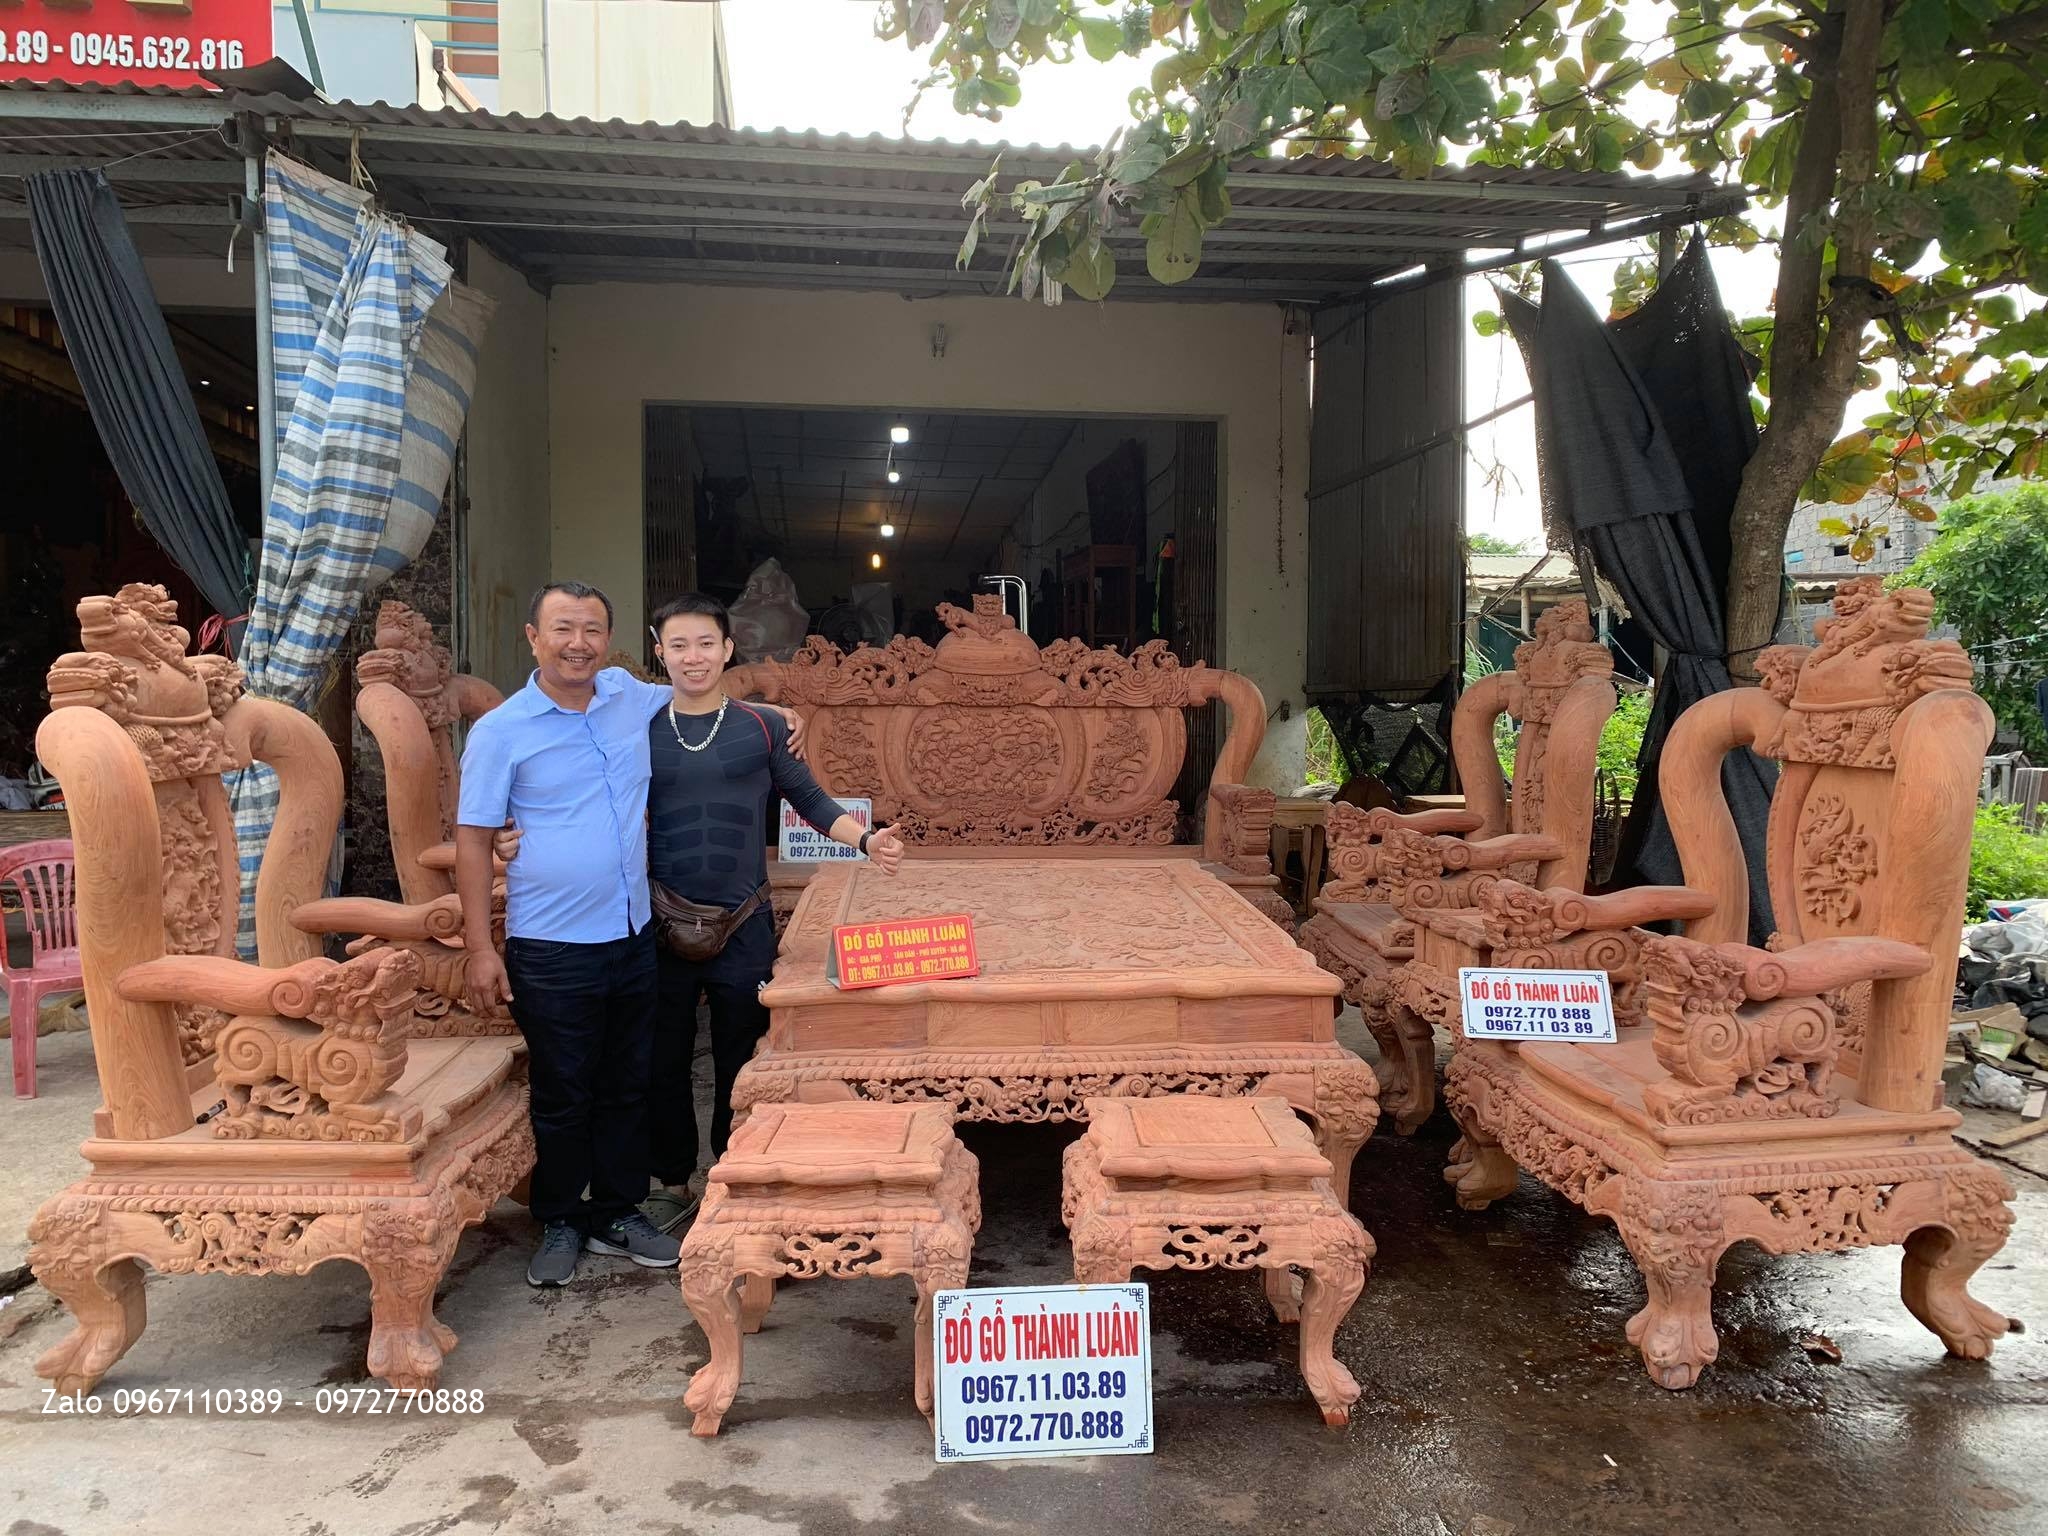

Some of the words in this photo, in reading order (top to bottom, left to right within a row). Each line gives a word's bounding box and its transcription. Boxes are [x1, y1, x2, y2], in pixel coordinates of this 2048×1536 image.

[70, 32, 244, 70] 0945.632.816
[790, 846, 857, 857] 0972.770.888
[843, 929, 862, 951] ĐỒ
[866, 927, 884, 949] GỖ
[886, 926, 930, 947] THÀNH
[933, 922, 967, 943] LUÂN
[862, 961, 915, 980] 0967.11.03.89
[921, 956, 969, 974] 0972.770.888
[1471, 976, 1490, 1000] ĐỒ
[1494, 976, 1511, 1001] GỖ
[1515, 979, 1560, 1002] THÀNH
[1563, 982, 1600, 1004] LUÂN
[1484, 1006, 1557, 1019] 0972.770
[1562, 1008, 1591, 1020] 888
[945, 1302, 973, 1364] ĐỒ
[979, 1299, 1006, 1362] GỖ
[1012, 1304, 1080, 1361] THÀNH
[1085, 1302, 1139, 1358] LUÂN
[961, 1370, 1127, 1405] 0967.11.03.89
[965, 1410, 1124, 1444] 0972.770.888
